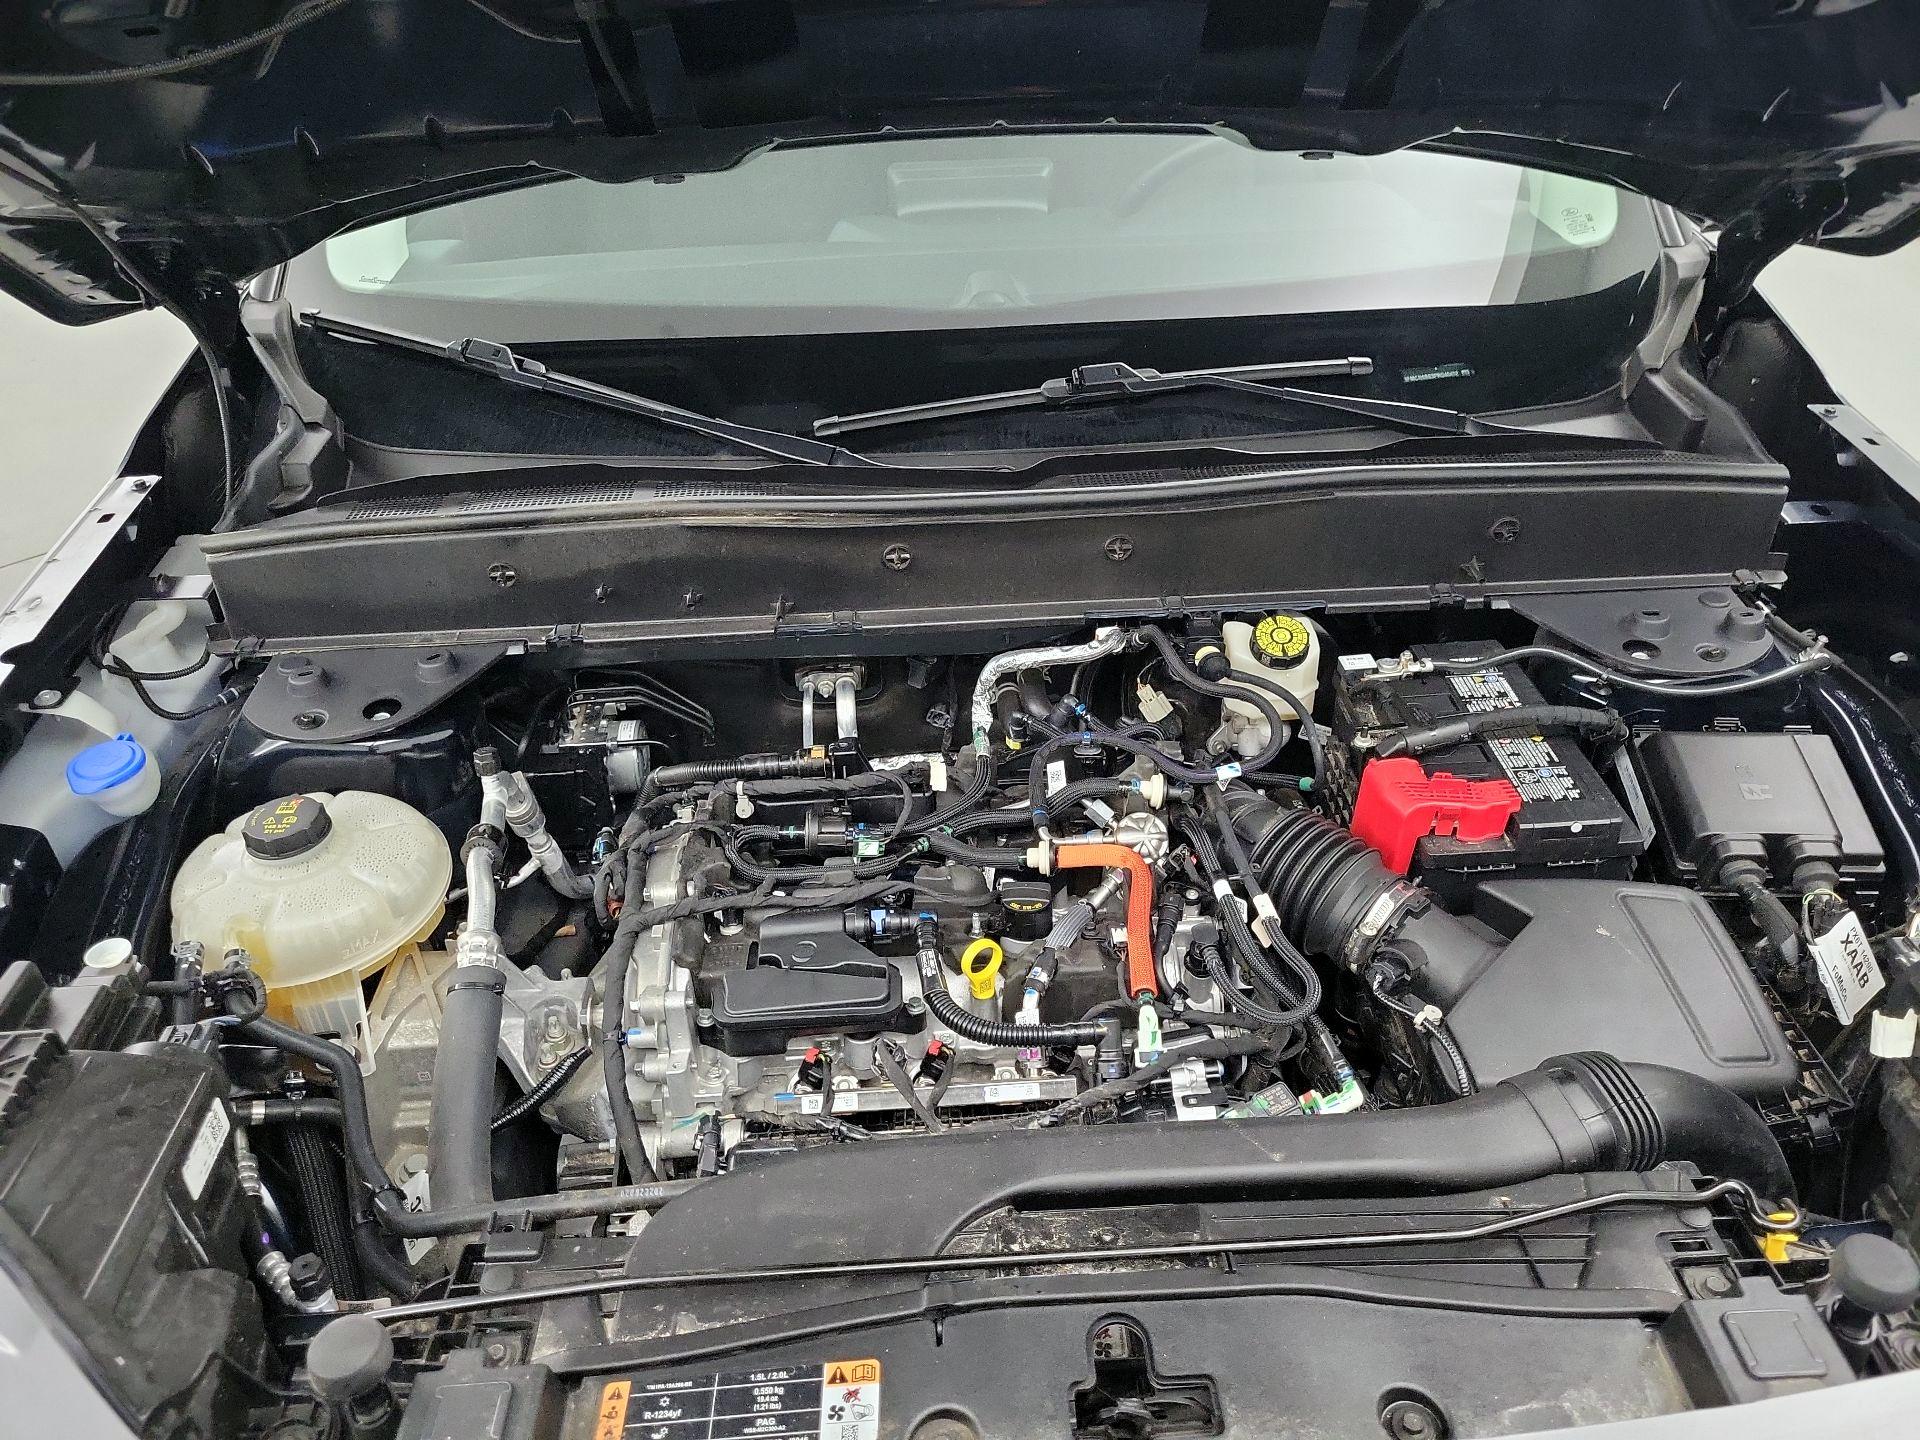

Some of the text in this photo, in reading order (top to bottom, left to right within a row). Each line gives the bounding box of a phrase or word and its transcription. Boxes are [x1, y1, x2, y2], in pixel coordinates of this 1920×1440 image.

[1840, 932, 1870, 989] XAAB
[754, 1386, 784, 1395] 0.550 kg
[753, 1402, 782, 1411] (1.21 lbs)
[643, 1409, 682, 1420] R-1234yf
[756, 1418, 775, 1426] PAG
